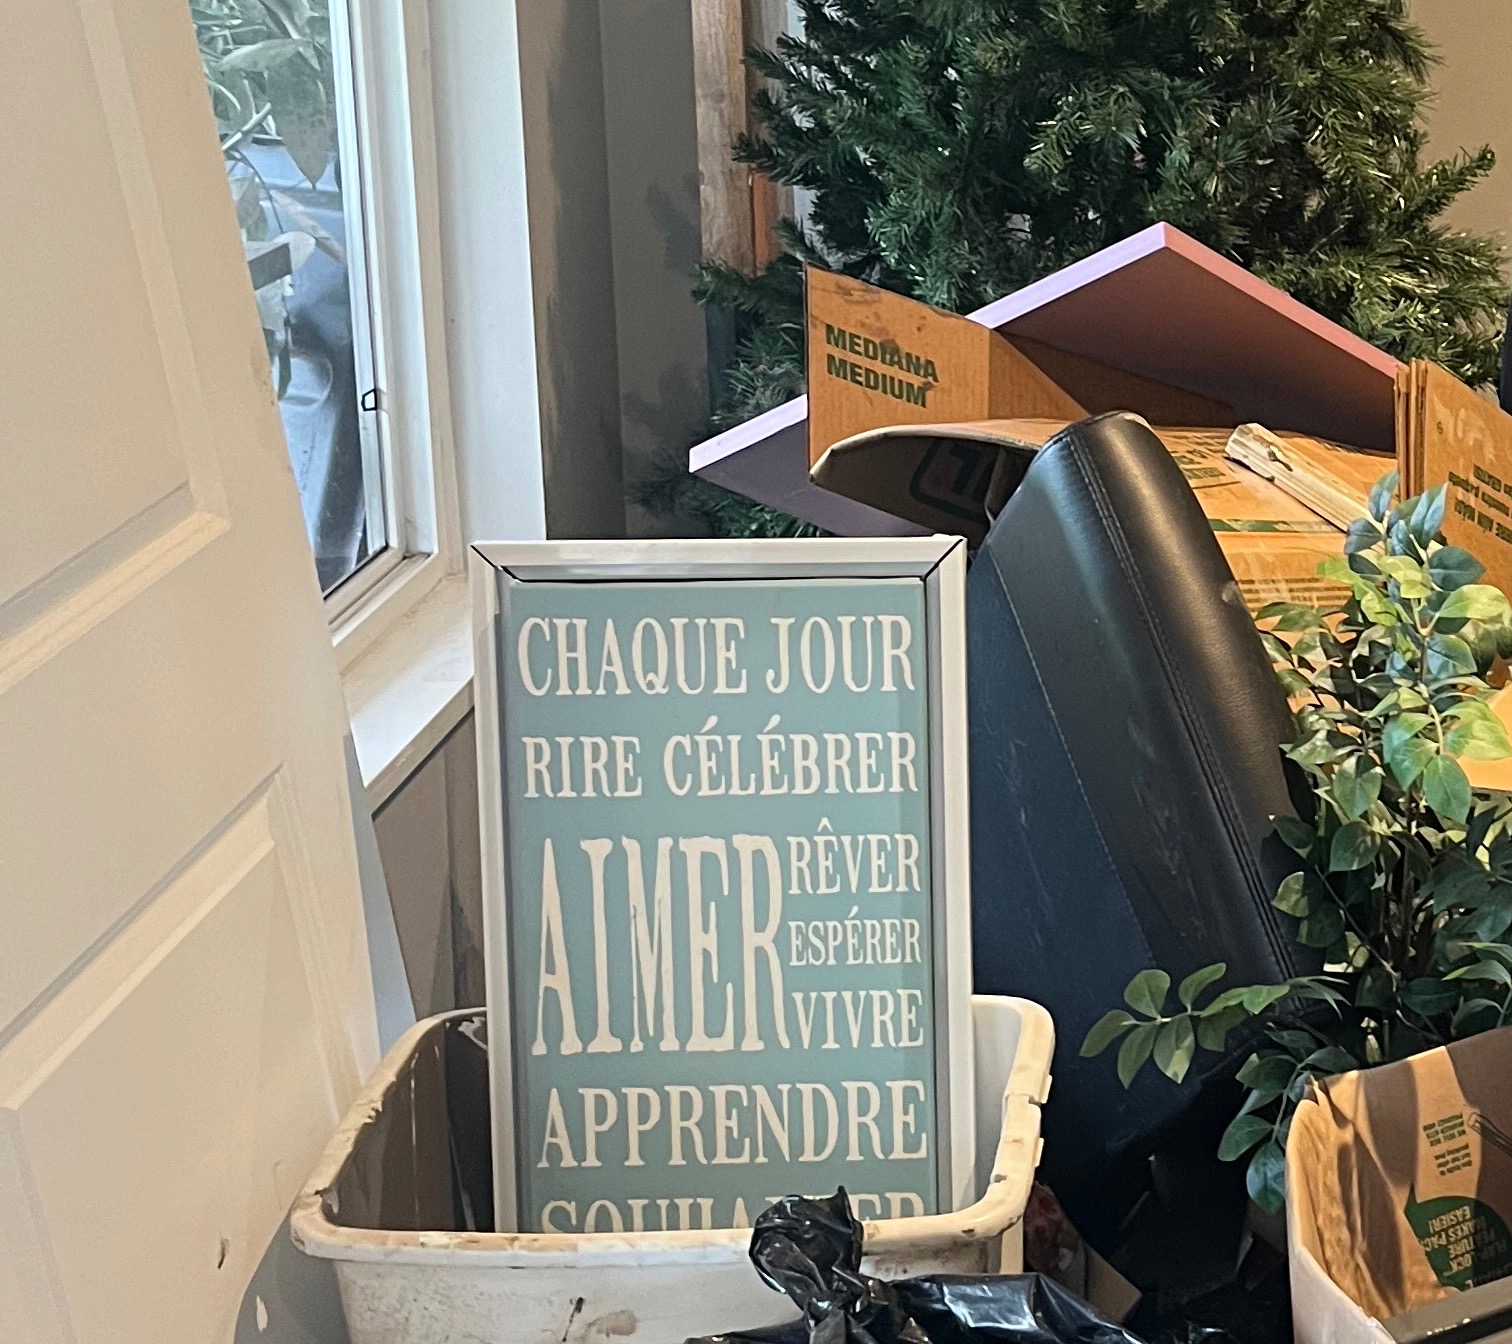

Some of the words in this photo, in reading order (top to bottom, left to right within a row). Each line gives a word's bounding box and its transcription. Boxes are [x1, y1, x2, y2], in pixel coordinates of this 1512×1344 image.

[823, 323, 939, 383] MEDIANA
[826, 353, 928, 409] MEDIUM
[518, 616, 746, 696] CHAQUE
[766, 614, 916, 694] JOUR
[521, 735, 642, 799] RIRE
[663, 715, 919, 797] CÉLÉBRER
[787, 817, 922, 895] RÊVER
[532, 834, 791, 1056] AIMER
[789, 907, 922, 966] ESPÉRER
[791, 989, 924, 1051] VIVRE
[537, 1079, 928, 1169] APPRENDRE
